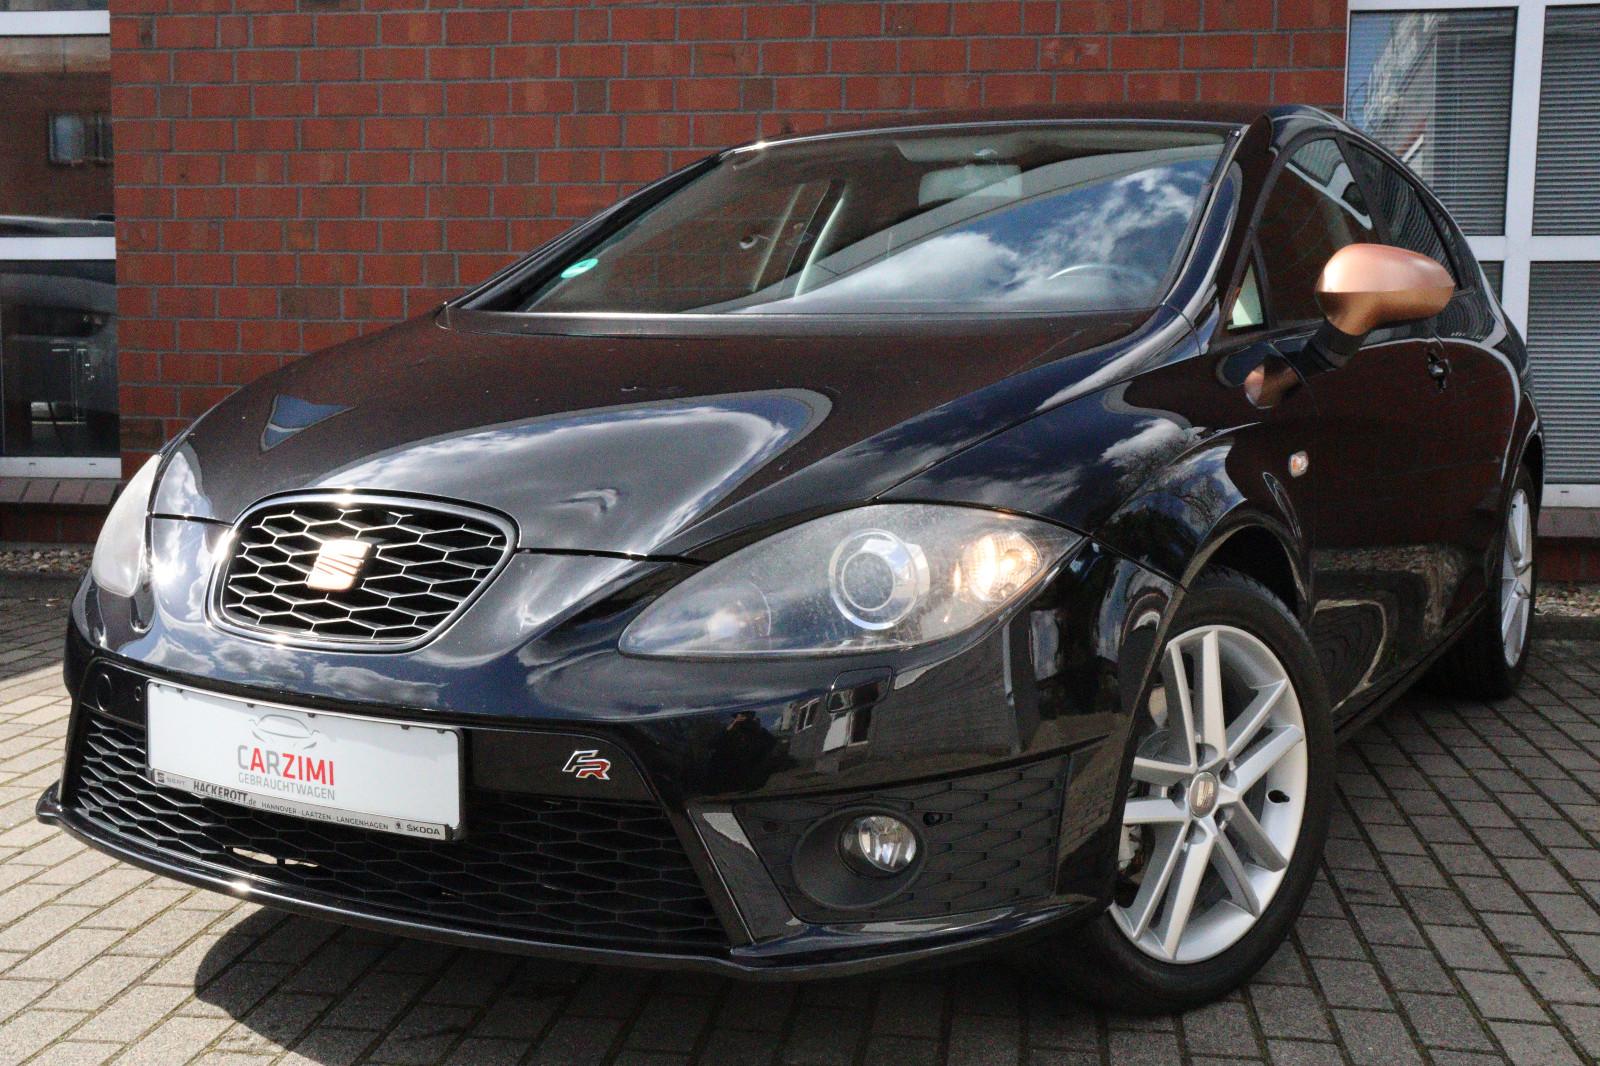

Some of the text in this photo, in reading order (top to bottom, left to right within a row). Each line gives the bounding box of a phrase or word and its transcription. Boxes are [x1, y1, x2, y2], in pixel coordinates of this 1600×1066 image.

[237, 745, 335, 786] CARZIMI
[562, 749, 611, 781] FR
[238, 772, 335, 801] GEBRAUCHTWAGEN
[261, 802, 297, 815] HANNOVER
[302, 809, 332, 821] LAATZEN
[336, 816, 389, 830] LANGENHAGEN
[406, 824, 441, 837] ŠKODA
